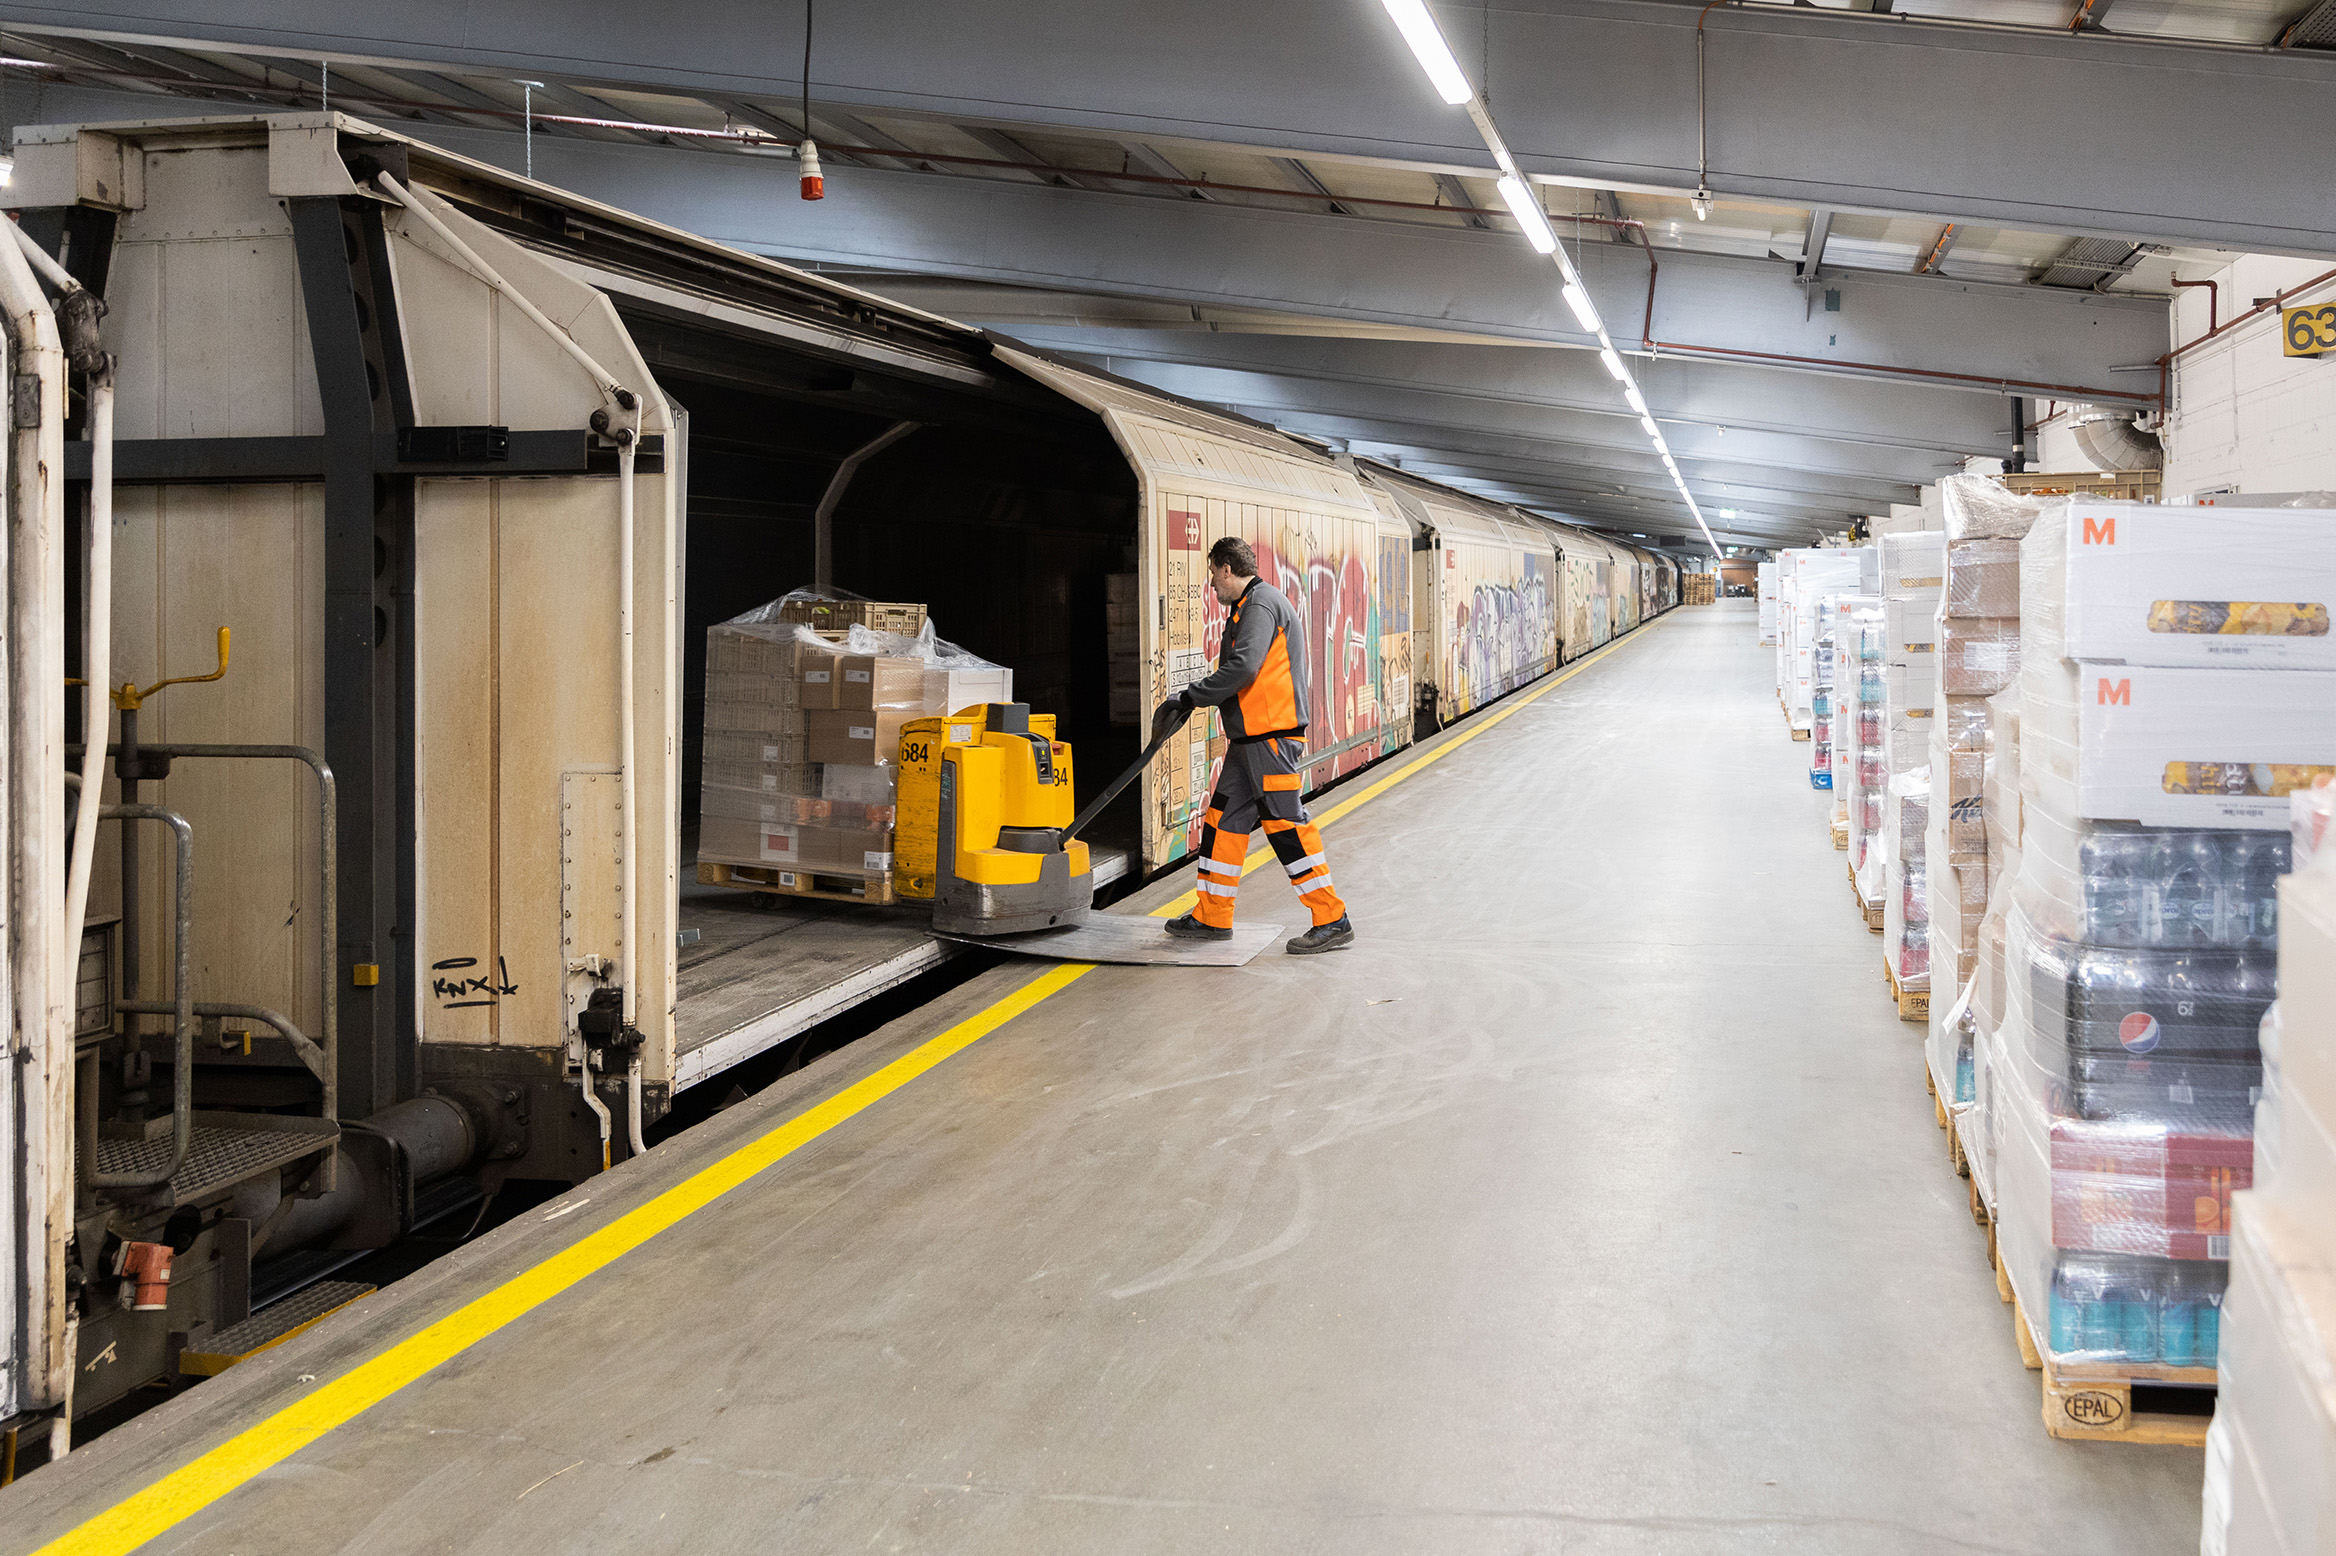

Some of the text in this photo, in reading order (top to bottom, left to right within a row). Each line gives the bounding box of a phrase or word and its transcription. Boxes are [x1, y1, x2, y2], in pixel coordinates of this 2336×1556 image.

[2083, 518, 2115, 545] M
[1841, 604, 1851, 613] M
[2098, 678, 2130, 705] M
[902, 742, 929, 763] 684
[2073, 1398, 2114, 1419] EPAL
